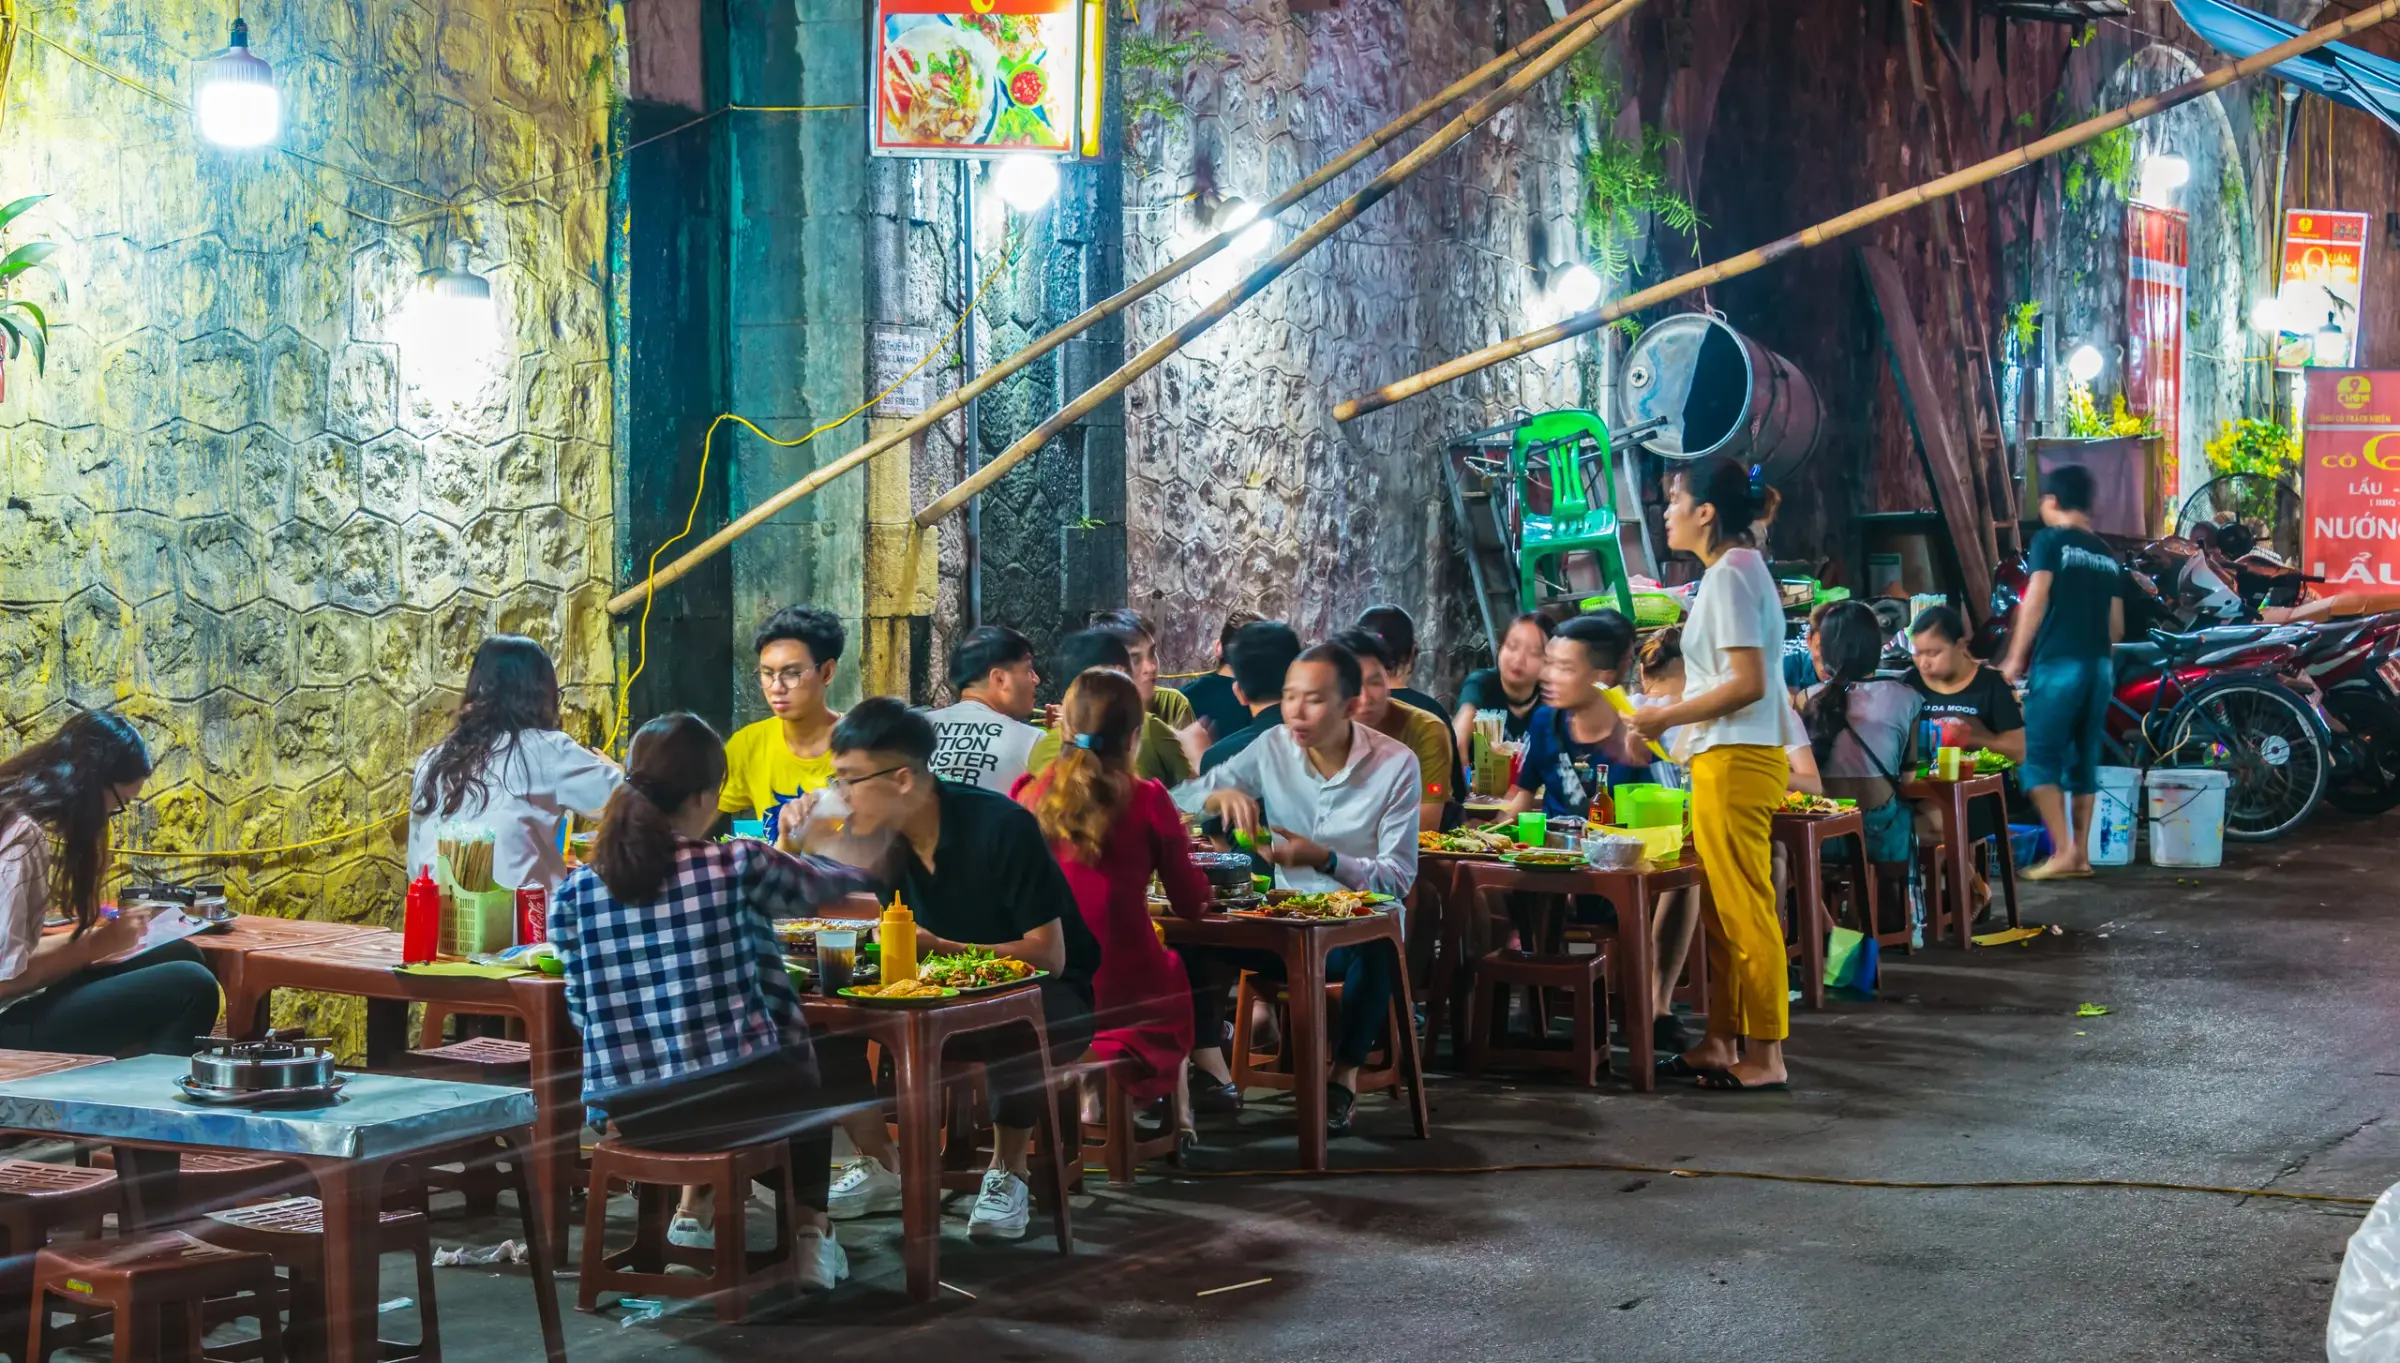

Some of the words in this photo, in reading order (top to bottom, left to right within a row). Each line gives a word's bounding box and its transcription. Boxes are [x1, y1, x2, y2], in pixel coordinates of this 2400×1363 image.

[2321, 453, 2357, 468] CÔ
[2314, 512, 2400, 539] NƯỚN
[1947, 704, 1978, 714] MOOD
[934, 722, 1003, 737] NTING
[938, 737, 991, 752] TION
[928, 752, 999, 772] NSTER
